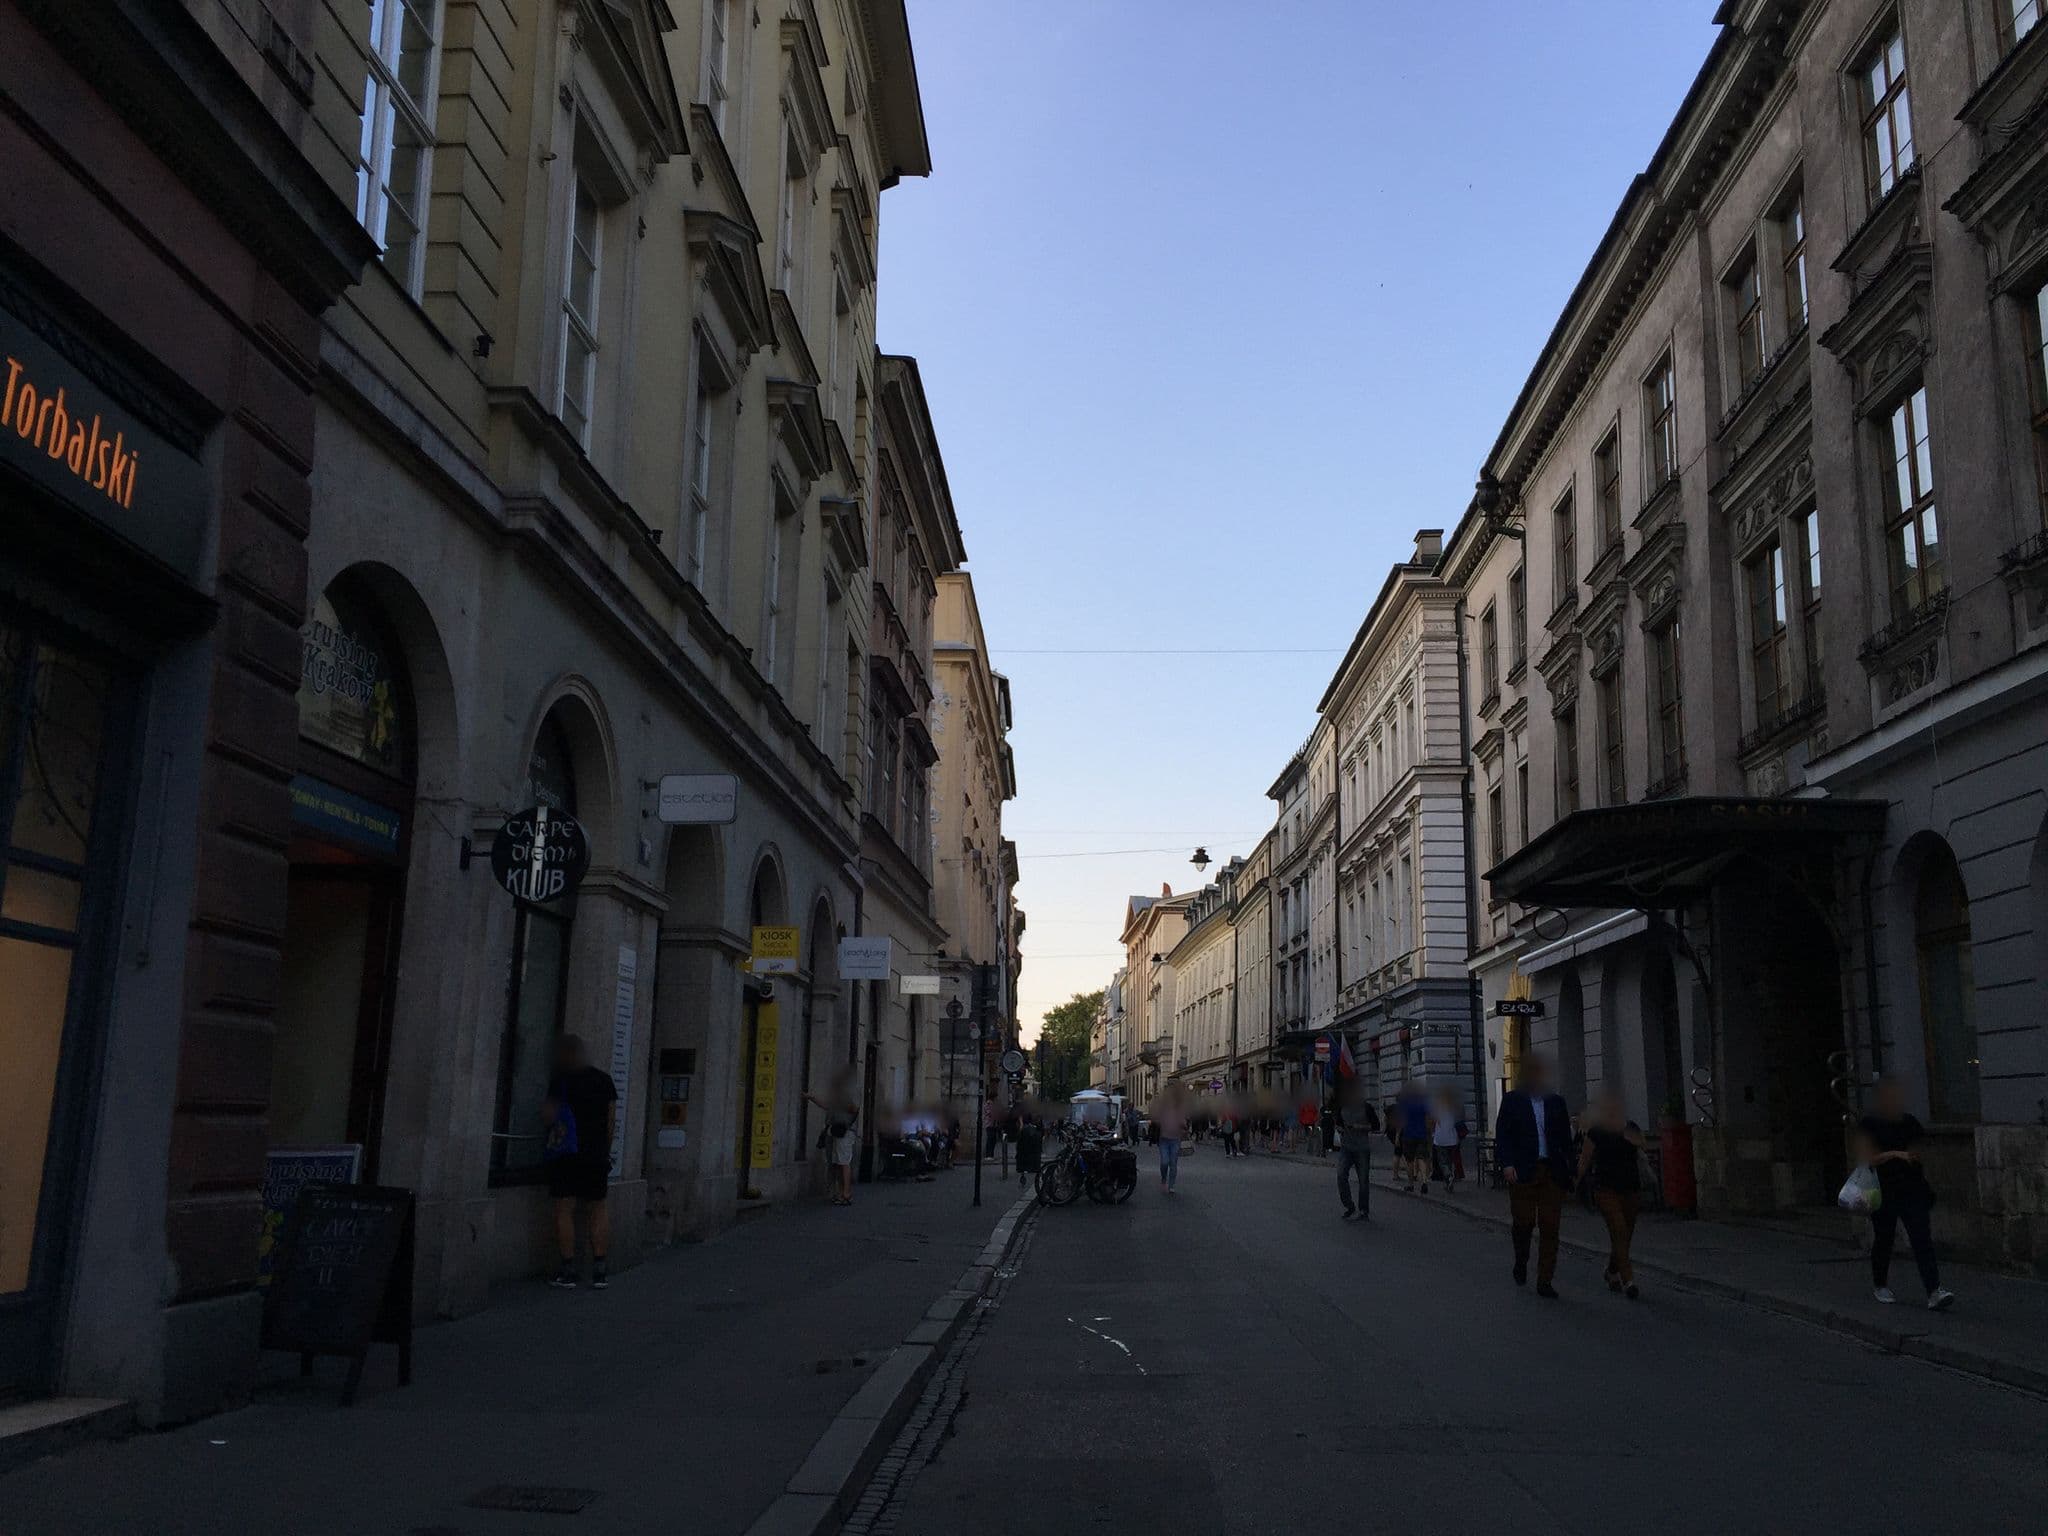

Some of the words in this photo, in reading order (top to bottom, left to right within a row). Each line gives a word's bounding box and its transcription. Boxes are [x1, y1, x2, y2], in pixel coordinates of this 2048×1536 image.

[1, 356, 139, 510] Torbalski
[506, 821, 577, 839] CARPE
[506, 868, 565, 902] KLUB
[760, 931, 793, 941] KIOSK
[267, 1160, 347, 1182] ruising
